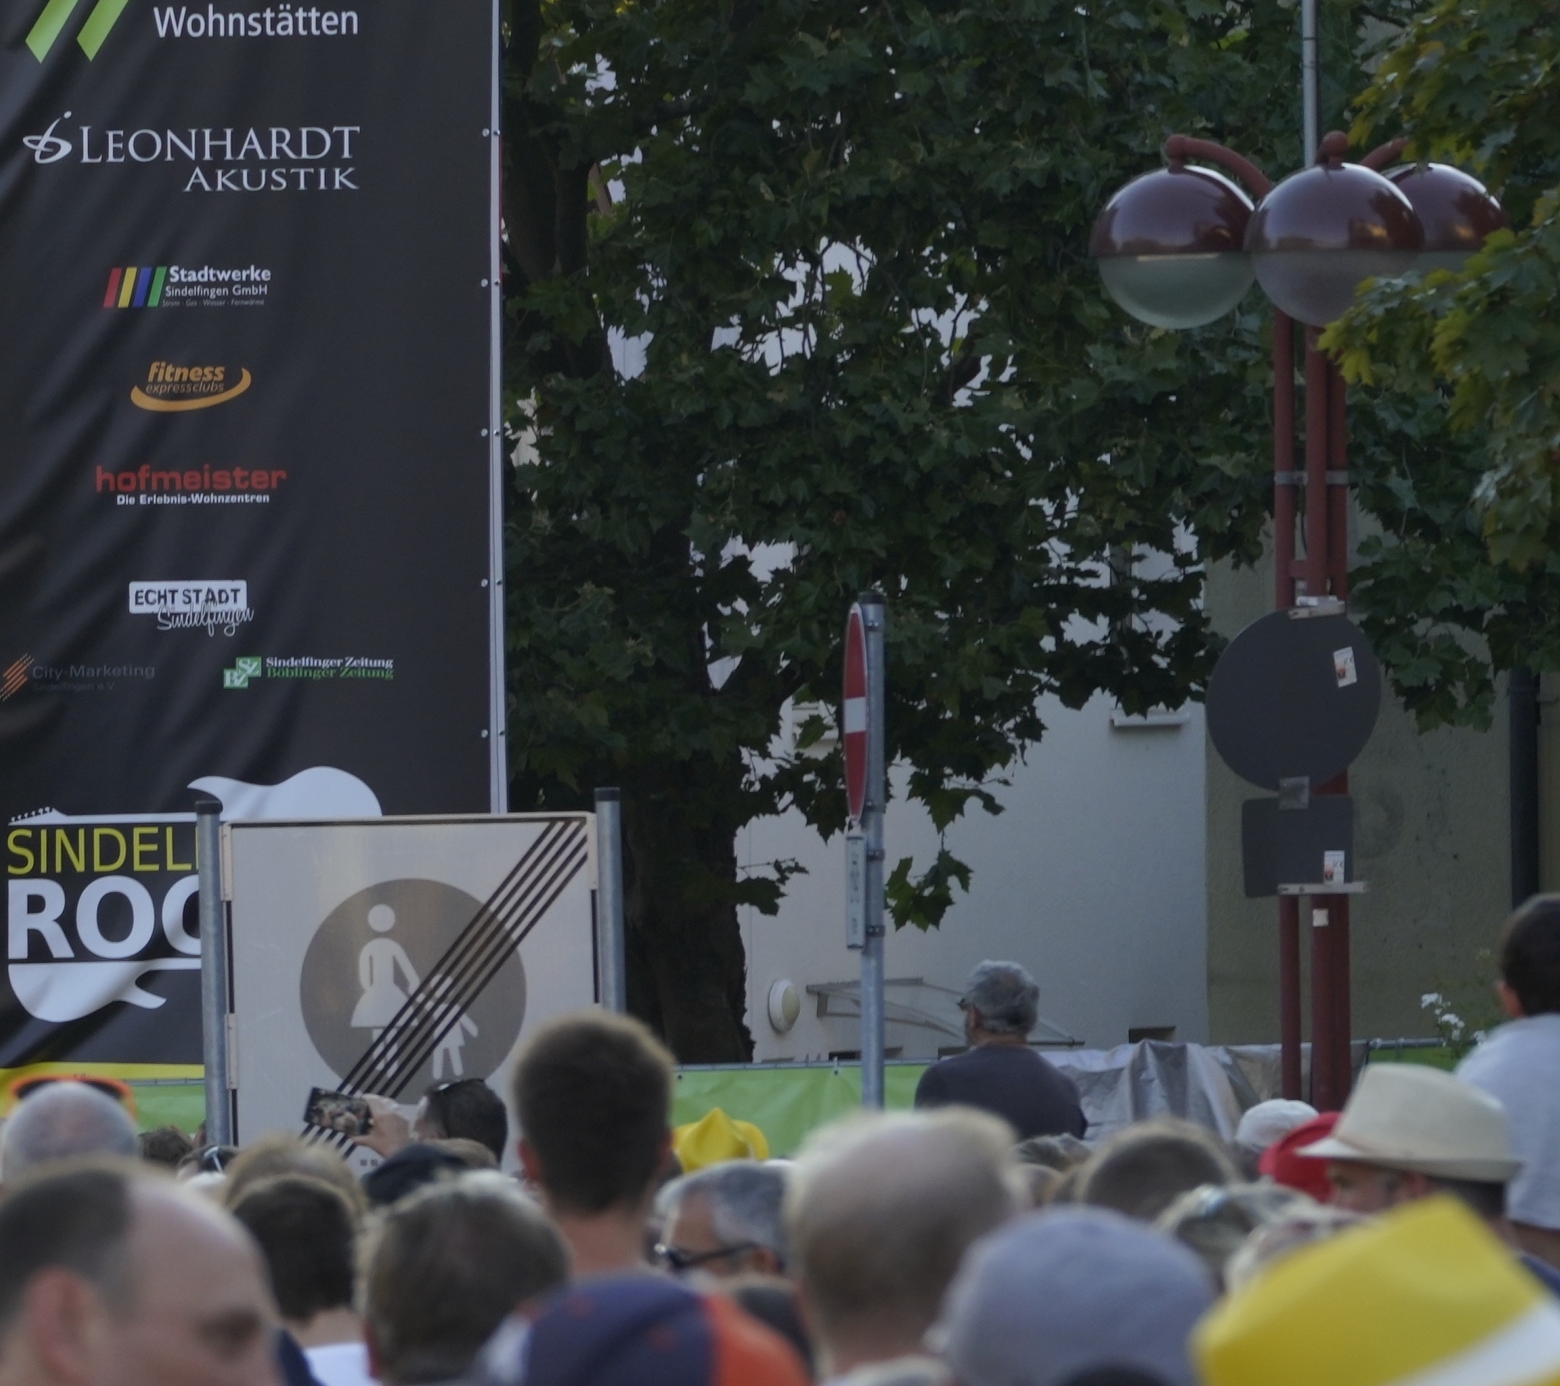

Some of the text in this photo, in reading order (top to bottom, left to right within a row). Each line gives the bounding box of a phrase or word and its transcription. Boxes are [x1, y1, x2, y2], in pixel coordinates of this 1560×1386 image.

[153, 4, 359, 38] Wohnstätten
[79, 127, 361, 163] LEONHARDT
[182, 166, 360, 192] AKUSTIK
[170, 265, 271, 282] Stadtwerke
[165, 284, 267, 298] Sindelfingen GmbH
[147, 362, 225, 382] fitness
[146, 380, 224, 395] expressclubs
[95, 464, 287, 492] hofmeister
[116, 493, 270, 505] Die Erlebnis-Wohnzentren
[135, 587, 240, 606] ECHT STADT
[156, 601, 254, 637] Sindelfingen
[32, 664, 155, 680] City-Marketing
[266, 656, 393, 669] Sindelfinger Zeitung
[267, 667, 394, 680] Böblinger Zeitung
[7, 826, 199, 875] SINDEL
